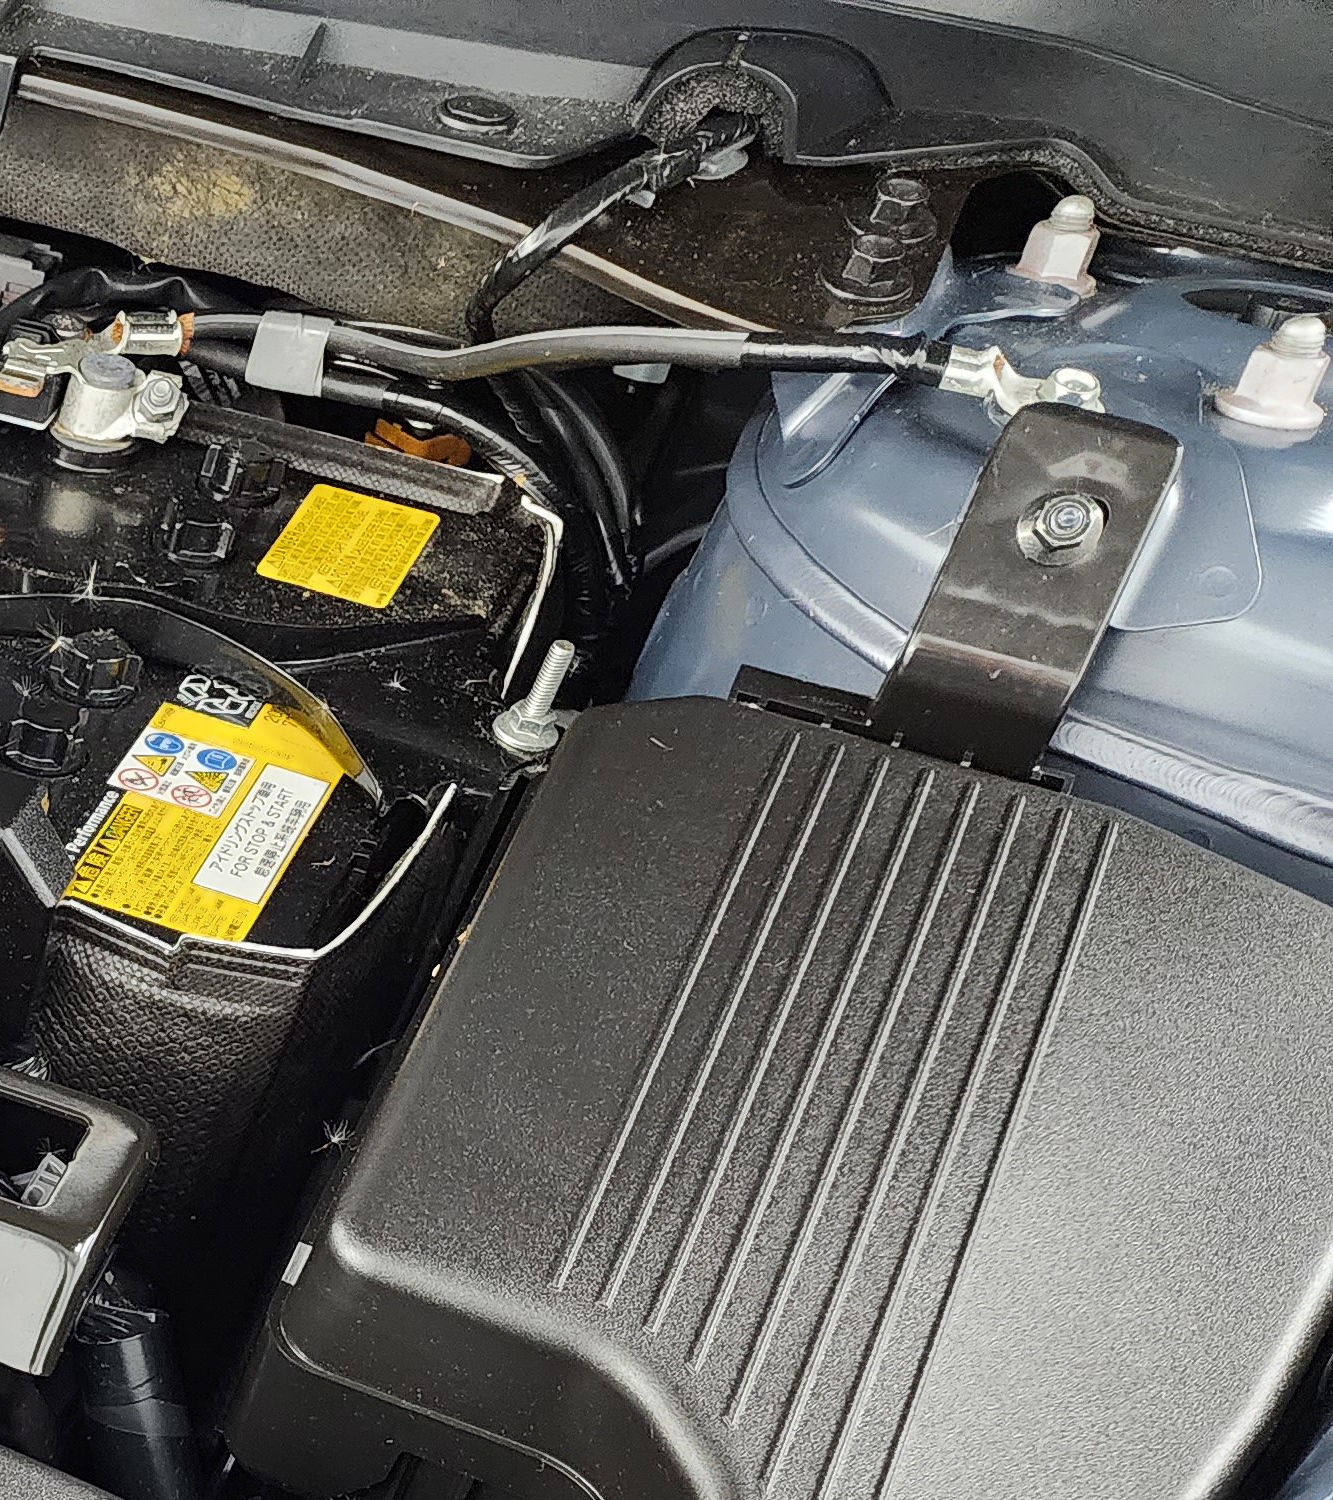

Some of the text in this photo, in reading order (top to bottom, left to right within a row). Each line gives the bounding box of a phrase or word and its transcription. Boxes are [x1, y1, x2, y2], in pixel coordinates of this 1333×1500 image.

[67, 789, 120, 857] Performance
[229, 854, 252, 878] FOR
[244, 826, 268, 856] STOP
[266, 787, 294, 819] START
